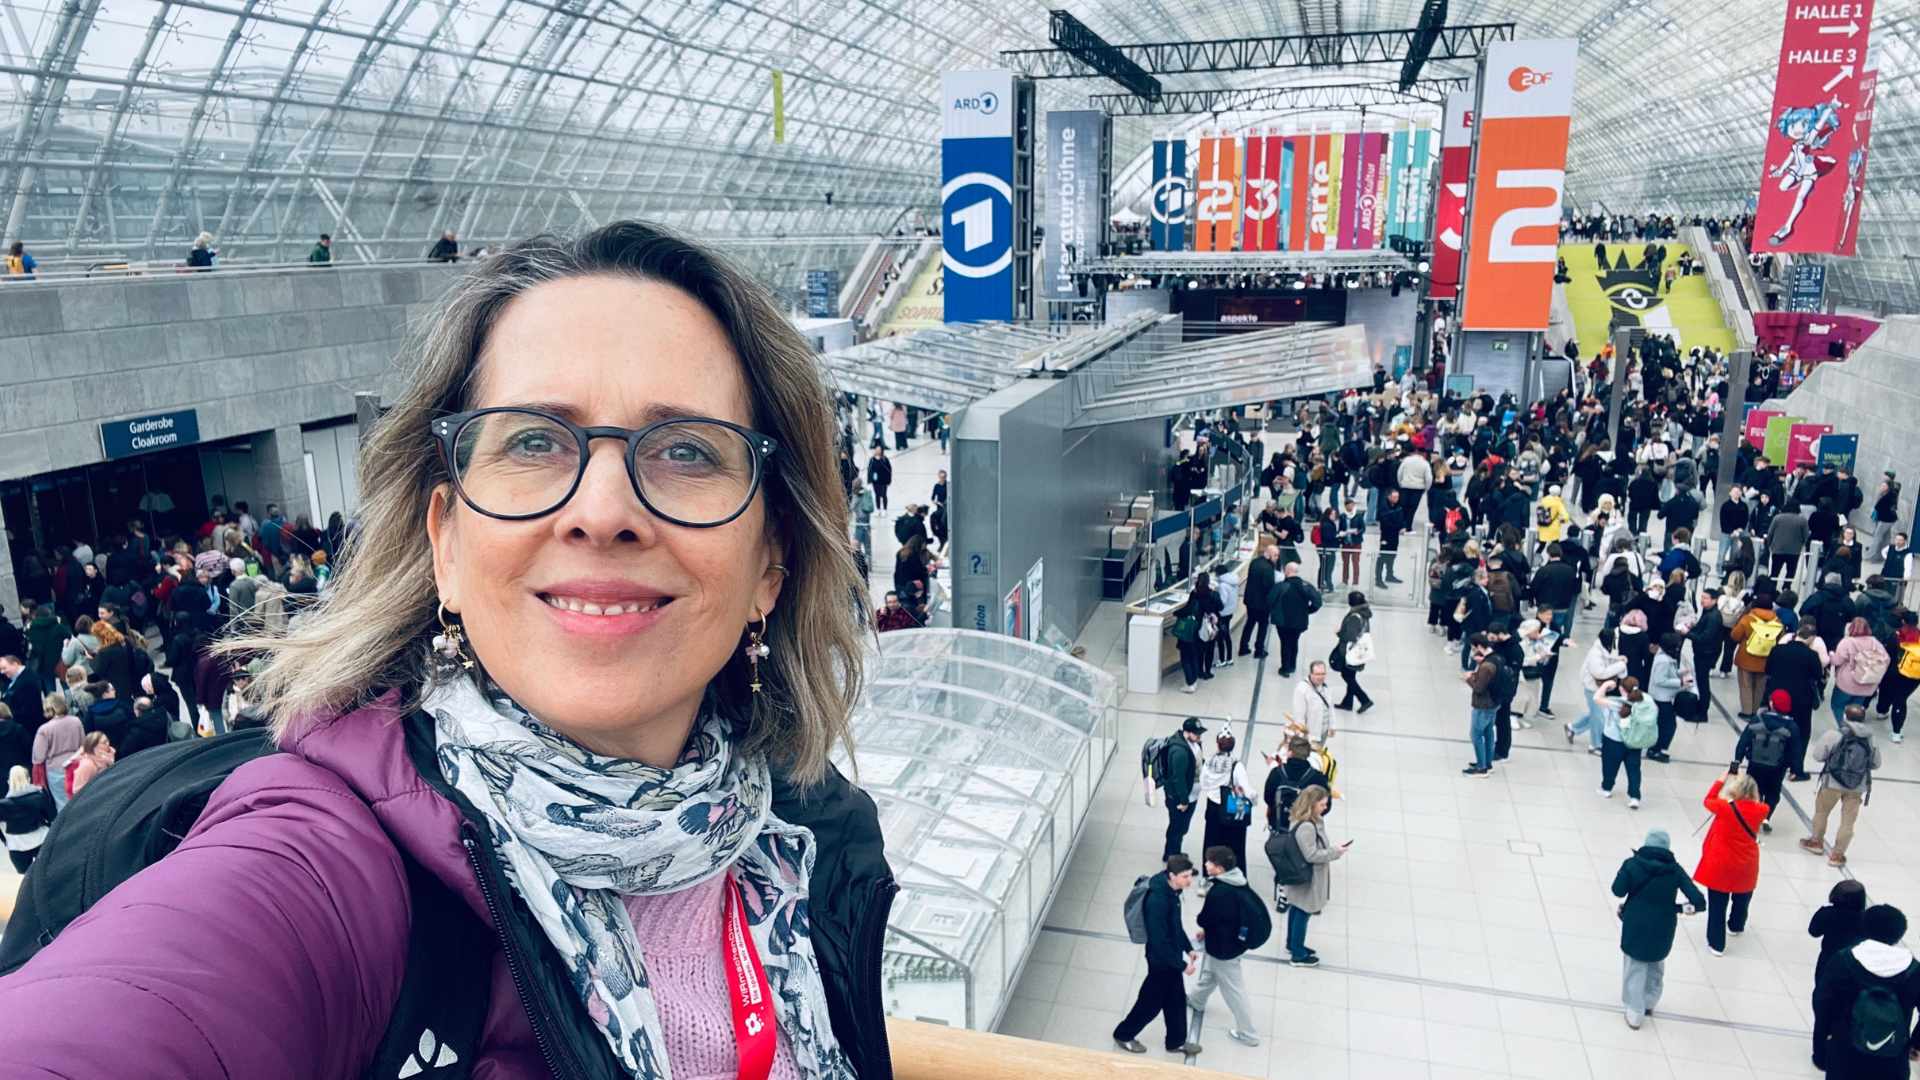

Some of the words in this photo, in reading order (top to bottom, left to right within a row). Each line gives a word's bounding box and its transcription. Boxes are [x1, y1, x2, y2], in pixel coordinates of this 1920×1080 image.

[1795, 4, 1851, 20] HALLE
[1853, 3, 1863, 18] 1
[1788, 49, 1844, 65] HALLE
[1846, 48, 1857, 63] 3
[1520, 71, 1553, 87] ZDF
[953, 97, 980, 110] ARD
[1197, 180, 1235, 221] 2
[1245, 178, 1279, 221] 3
[1310, 160, 1329, 234] arte
[950, 196, 993, 253] 1
[1488, 168, 1566, 263] 2
[129, 416, 174, 434] Garderobe
[131, 433, 177, 450] Cloakroom
